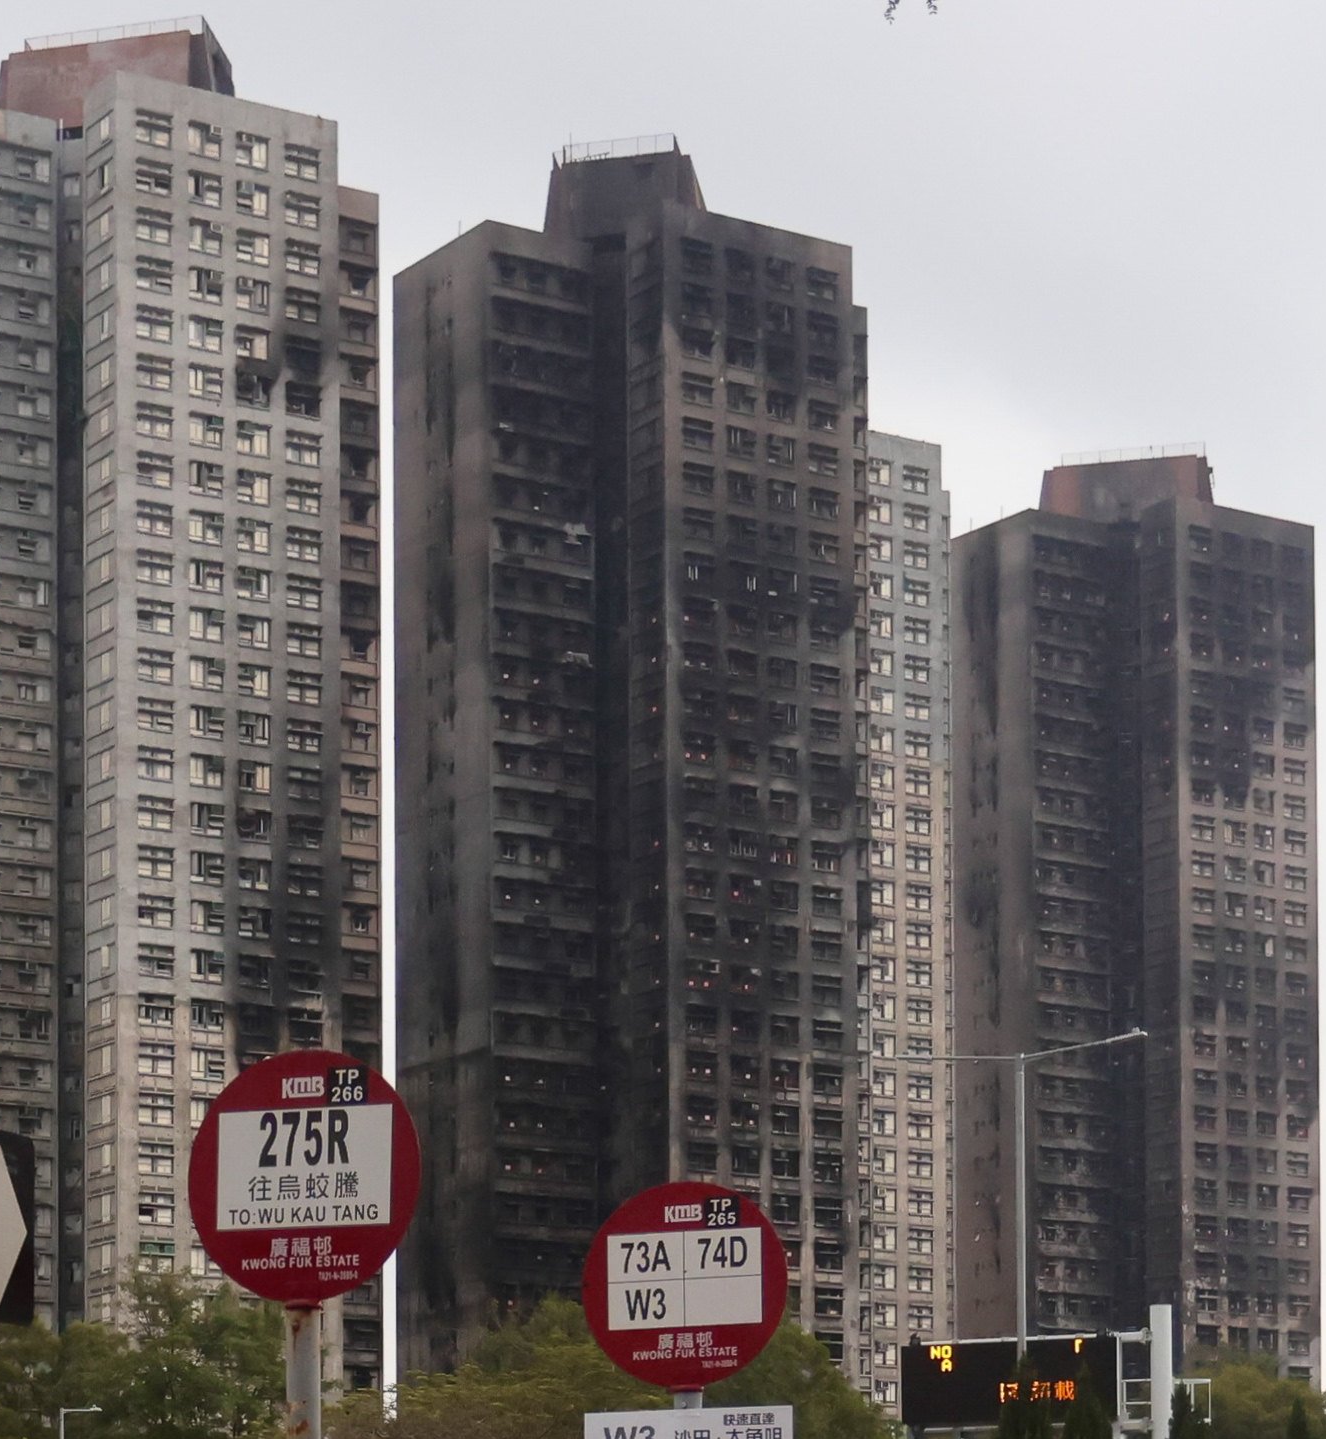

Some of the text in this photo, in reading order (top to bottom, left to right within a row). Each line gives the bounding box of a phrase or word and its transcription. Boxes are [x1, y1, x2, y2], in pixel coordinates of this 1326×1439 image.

[335, 1069, 360, 1085] TP
[281, 1076, 325, 1099] KMB
[331, 1086, 364, 1103] 266
[258, 1108, 350, 1168] 275R
[248, 1171, 360, 1203] 往烏蛟騰
[290, 1205, 327, 1222] KAU
[332, 1203, 379, 1222] TANG
[664, 1203, 703, 1223] KMB
[710, 1198, 733, 1212] TP
[707, 1212, 737, 1226] 265
[269, 1236, 333, 1258] 廣福邨
[620, 1235, 748, 1274] 73A 74D
[241, 1254, 361, 1271] KWONG FUK ESTATE
[625, 1287, 667, 1321] W3
[657, 1331, 713, 1350] 廣福邨
[632, 1346, 738, 1361] KWONG FUK ESTATE
